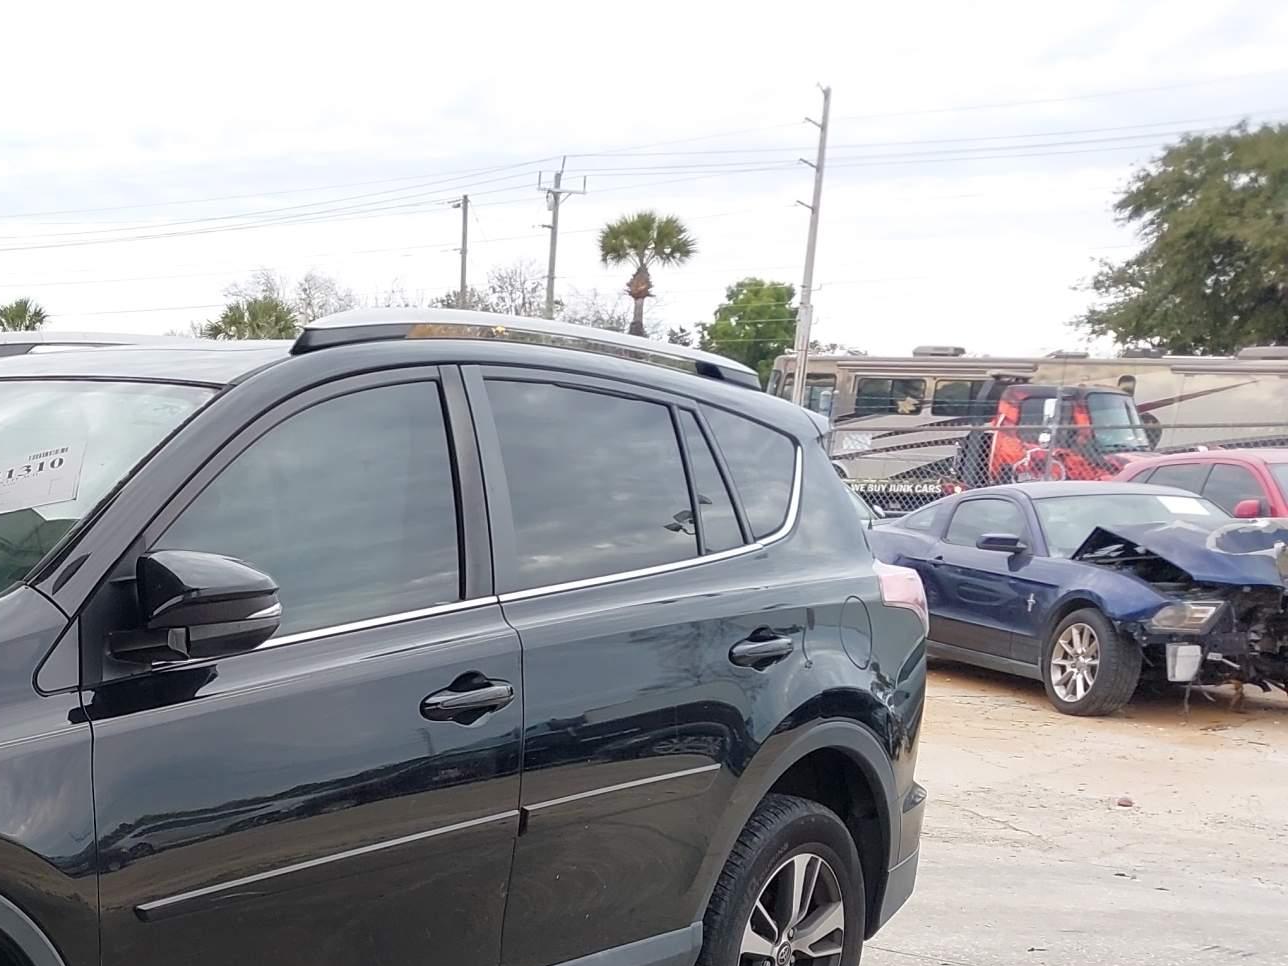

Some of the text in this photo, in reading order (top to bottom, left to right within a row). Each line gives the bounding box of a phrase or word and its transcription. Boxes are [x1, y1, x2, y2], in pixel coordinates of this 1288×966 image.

[867, 484, 888, 492] BUY
[889, 484, 913, 493] JUNK
[914, 484, 942, 493] CARS
